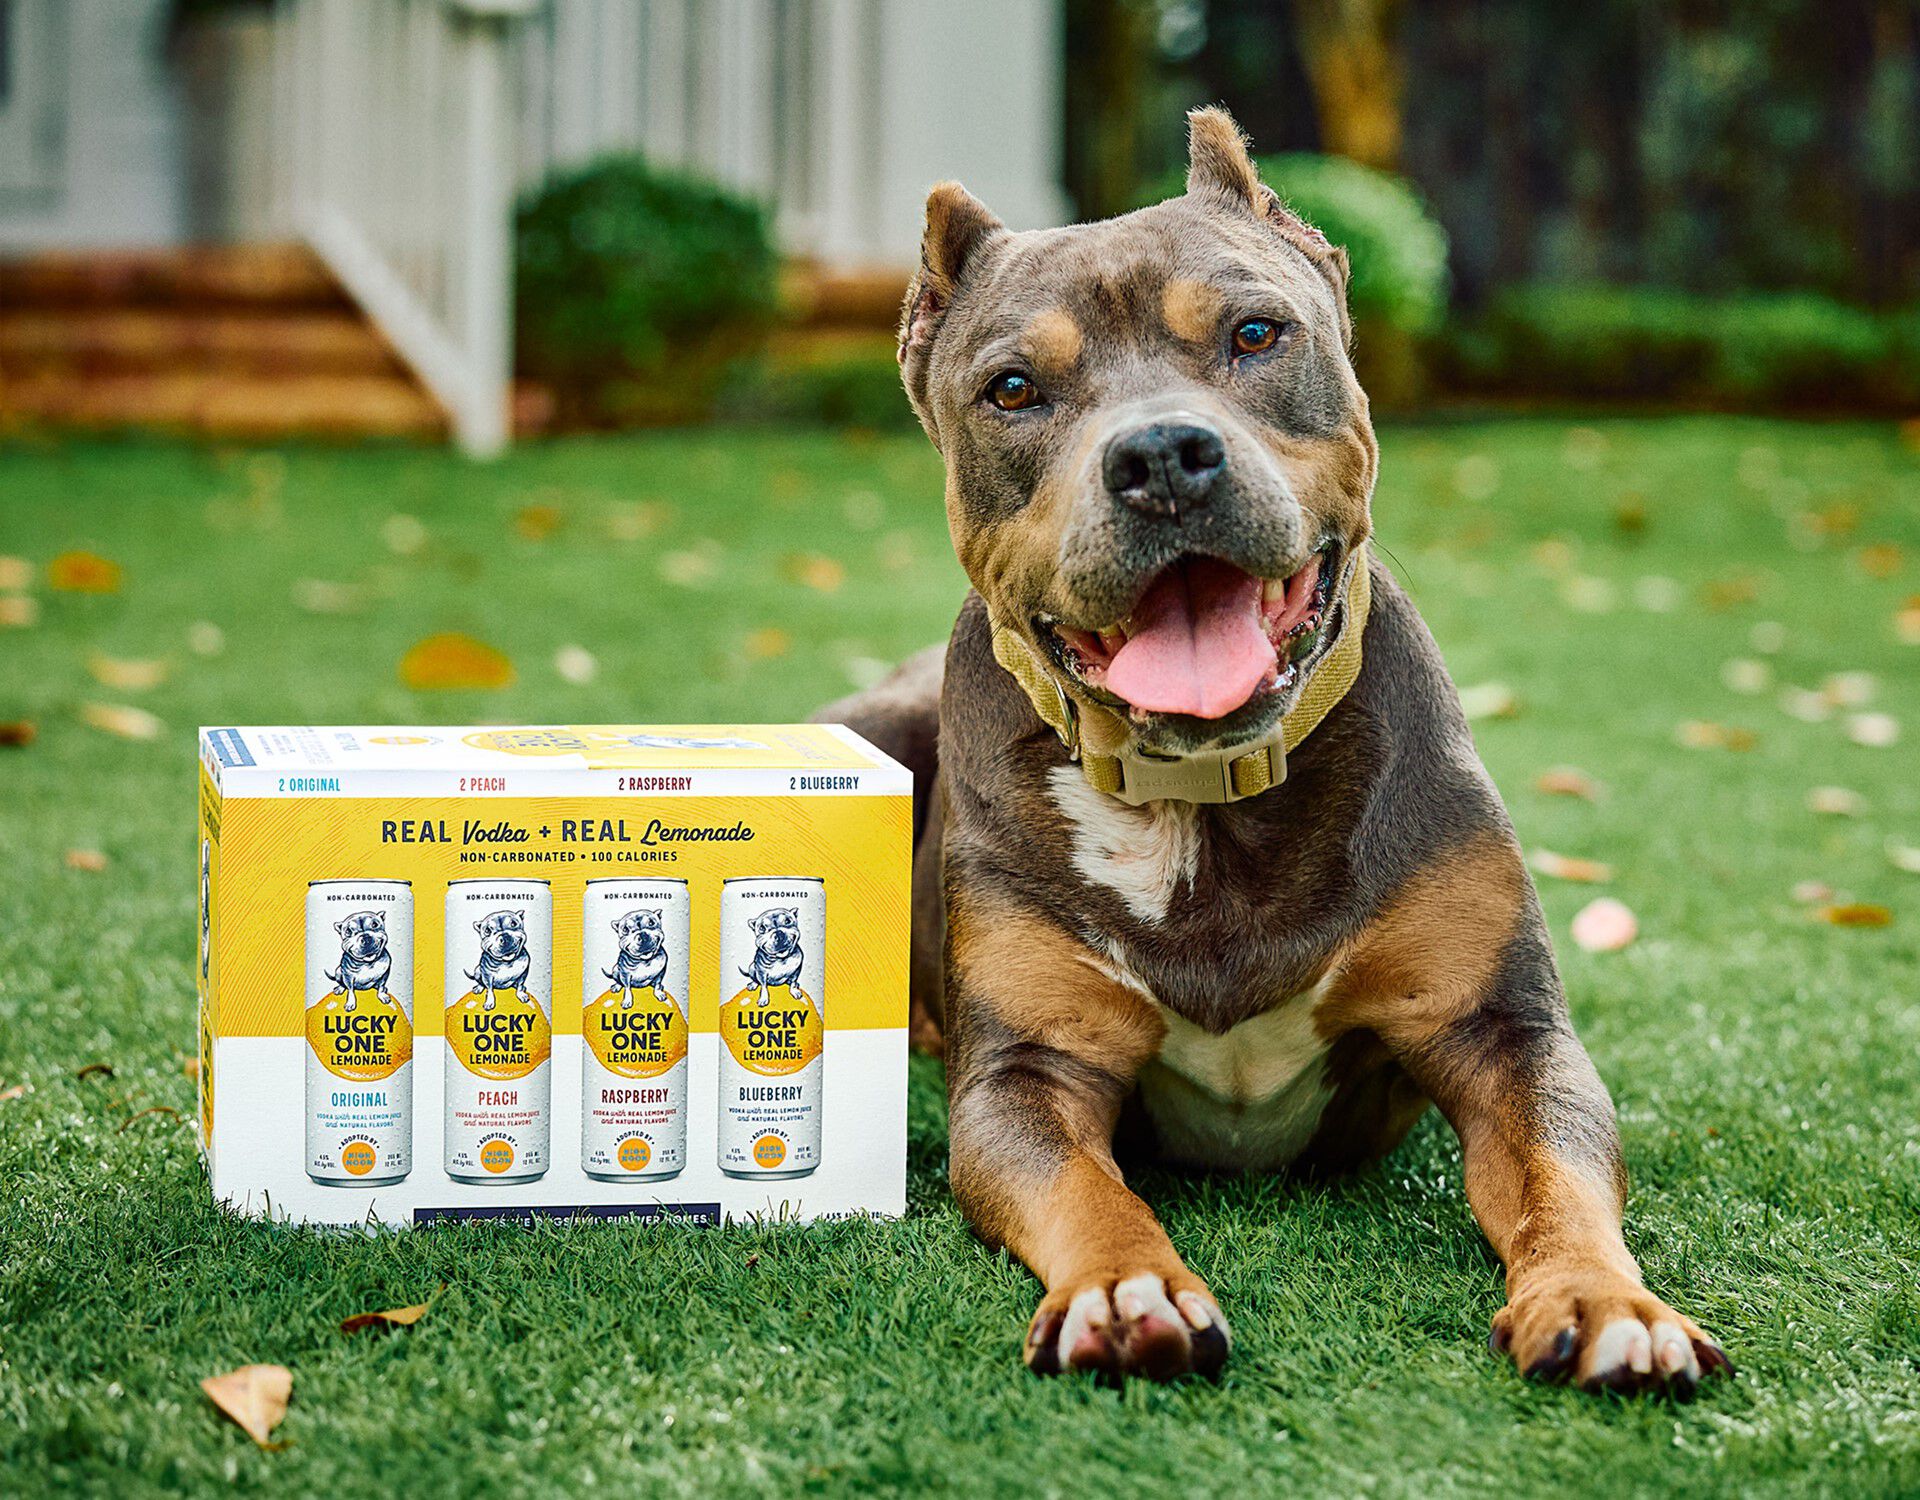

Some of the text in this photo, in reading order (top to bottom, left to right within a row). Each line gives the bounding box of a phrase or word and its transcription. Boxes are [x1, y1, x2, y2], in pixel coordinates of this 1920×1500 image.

[278, 778, 341, 792] 2 ORIGINAL
[460, 778, 506, 792] 2 PEACH
[618, 777, 692, 791] 2 RASPBERRY
[790, 776, 859, 790] 2 BLUEBERRY
[382, 819, 755, 847] REAL Vodka + REAL Lemonade
[459, 851, 678, 863] NON-CARBONATED 100 CALORIES
[325, 1015, 397, 1033] LUCKY
[464, 1014, 536, 1032] LUCKY
[602, 1013, 673, 1031] LUCKY
[738, 1010, 808, 1029] LUCKY
[335, 1036, 384, 1052] ONE
[474, 1034, 523, 1051] ONE
[612, 1033, 661, 1050] ONE
[748, 1030, 796, 1048] ONE
[331, 1055, 391, 1065] LEMONADE
[470, 1053, 530, 1064] LEMONADE
[608, 1052, 667, 1062] LEMONADE
[744, 1049, 802, 1060] LEMONADE
[331, 1092, 388, 1107] ORIGINAL
[479, 1091, 518, 1105] PEACH
[602, 1088, 669, 1103] RASPBERRY
[740, 1085, 803, 1101] BLUEBERRY
[341, 1134, 378, 1146] ADOPTED BY
[480, 1133, 506, 1144] ADOPTED
[616, 1131, 653, 1142] ADOPTED BY
[752, 1128, 788, 1140] ADOPTED BY
